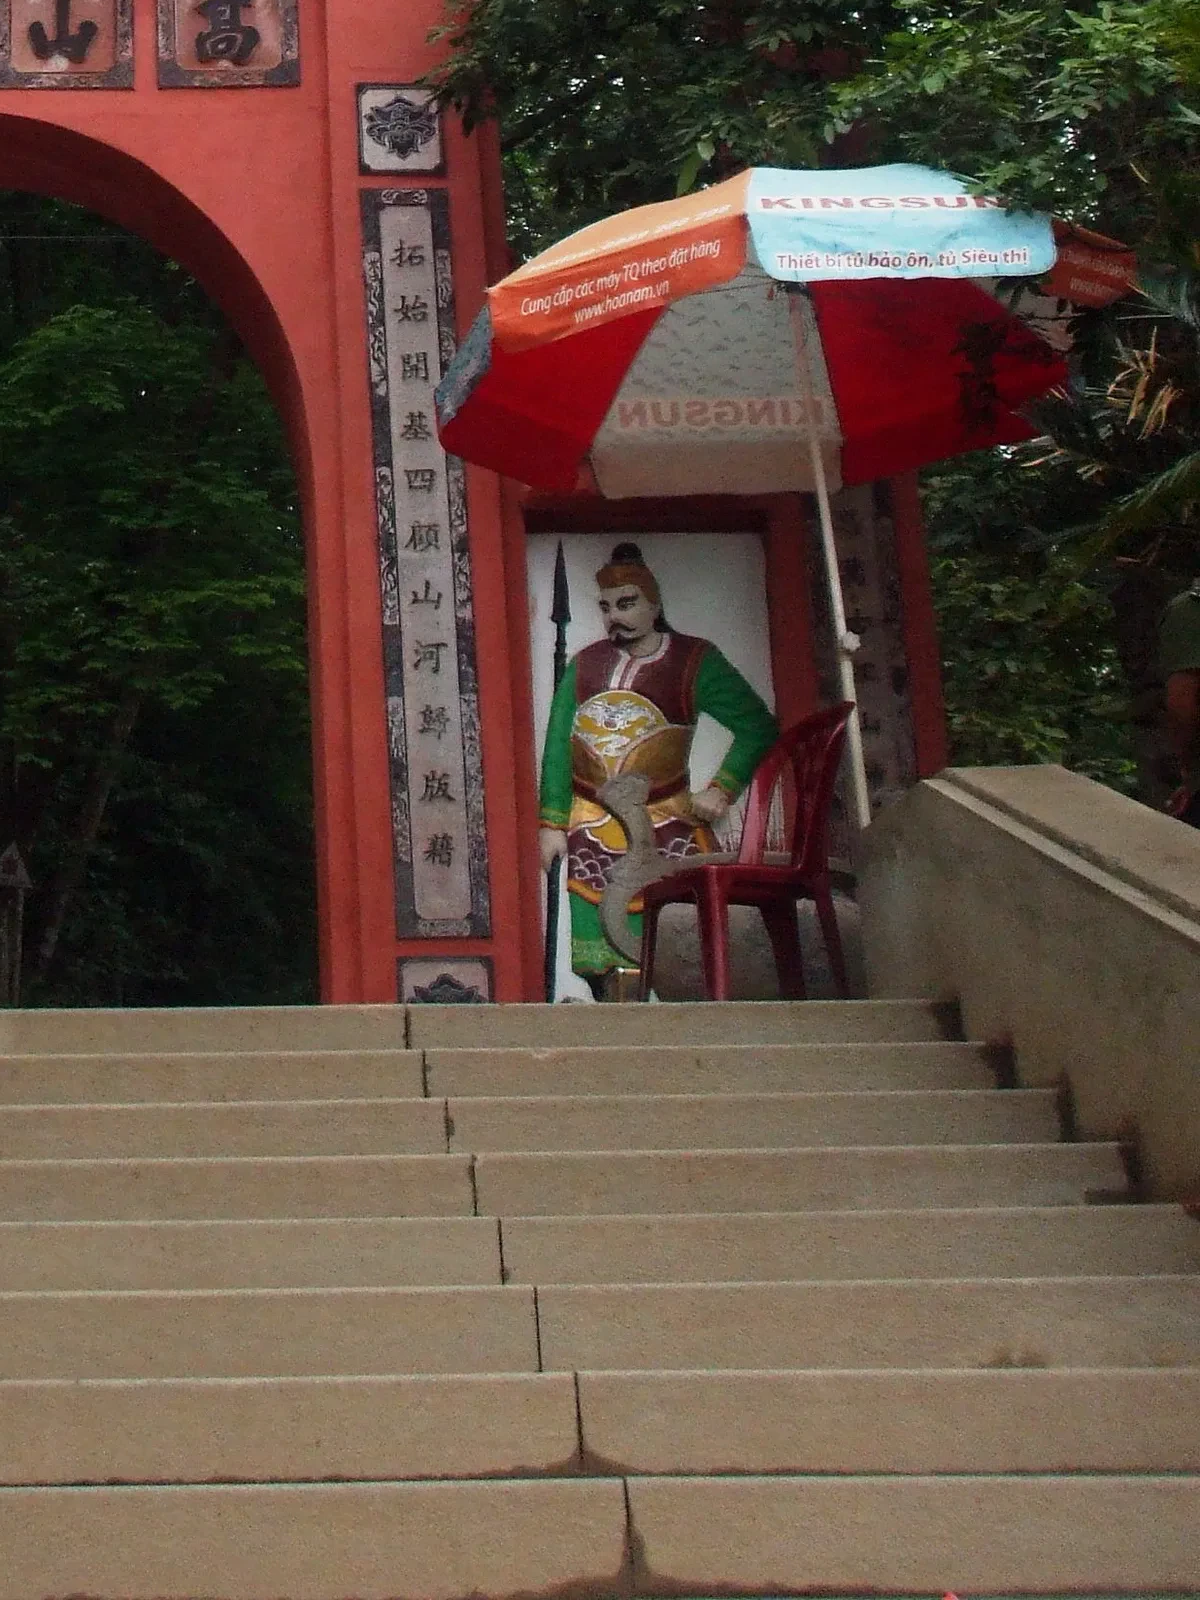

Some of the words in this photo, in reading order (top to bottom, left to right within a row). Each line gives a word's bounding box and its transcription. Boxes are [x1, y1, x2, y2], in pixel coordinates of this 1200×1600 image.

[760, 196, 1006, 209] KINGSUN
[777, 253, 820, 269] Thiết
[826, 253, 842, 271] bị
[847, 250, 863, 267] tủ
[939, 250, 956, 267] tủ
[961, 249, 998, 265] Siêu
[1003, 248, 1028, 266] thị
[520, 295, 552, 316] Cung
[552, 285, 574, 309] cấp
[575, 280, 595, 298] các
[596, 273, 623, 293] máy
[623, 263, 641, 282] TQ
[640, 258, 667, 277] theo
[668, 247, 689, 269] đặt
[689, 239, 721, 260] hàng
[574, 280, 669, 323] www.hoanam.vn
